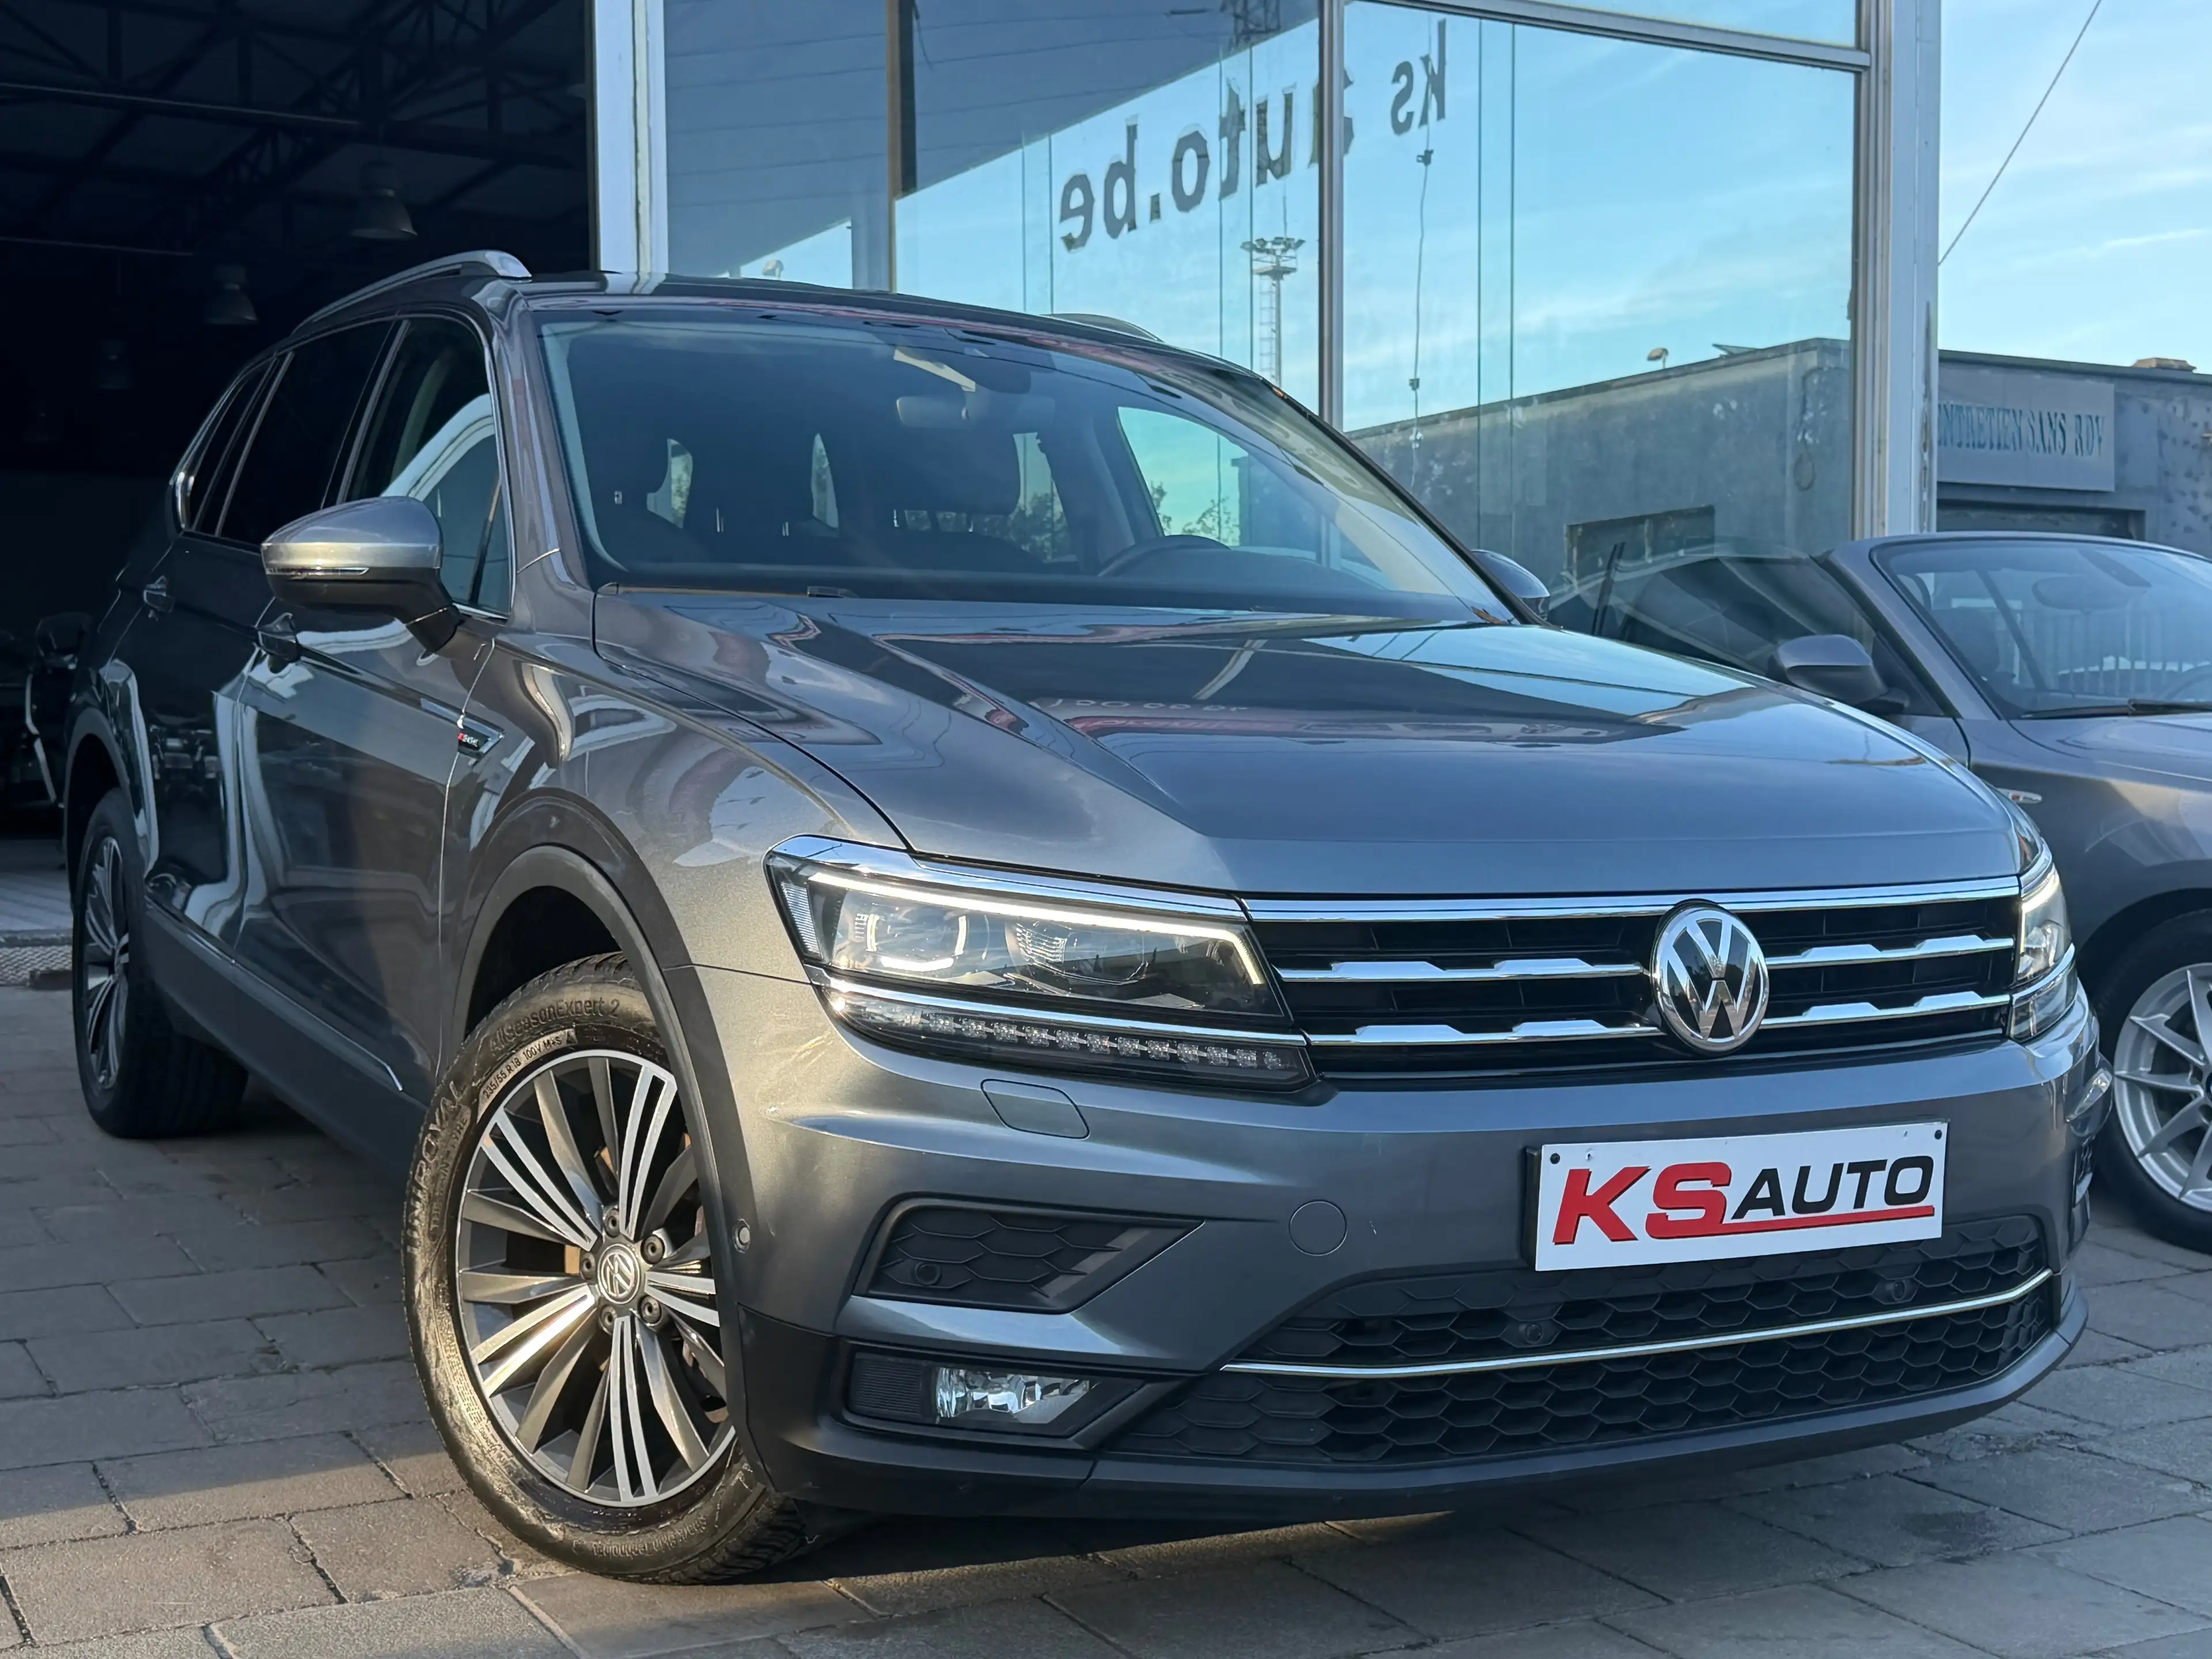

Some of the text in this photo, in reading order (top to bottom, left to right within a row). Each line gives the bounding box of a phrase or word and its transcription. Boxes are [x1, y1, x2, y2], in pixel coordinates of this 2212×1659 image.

[2027, 410, 2066, 456] SANS
[608, 998, 620, 1017] 2
[506, 1063, 514, 1075] R
[512, 1057, 521, 1069] 18
[406, 1080, 468, 1253] UNIROYAL
